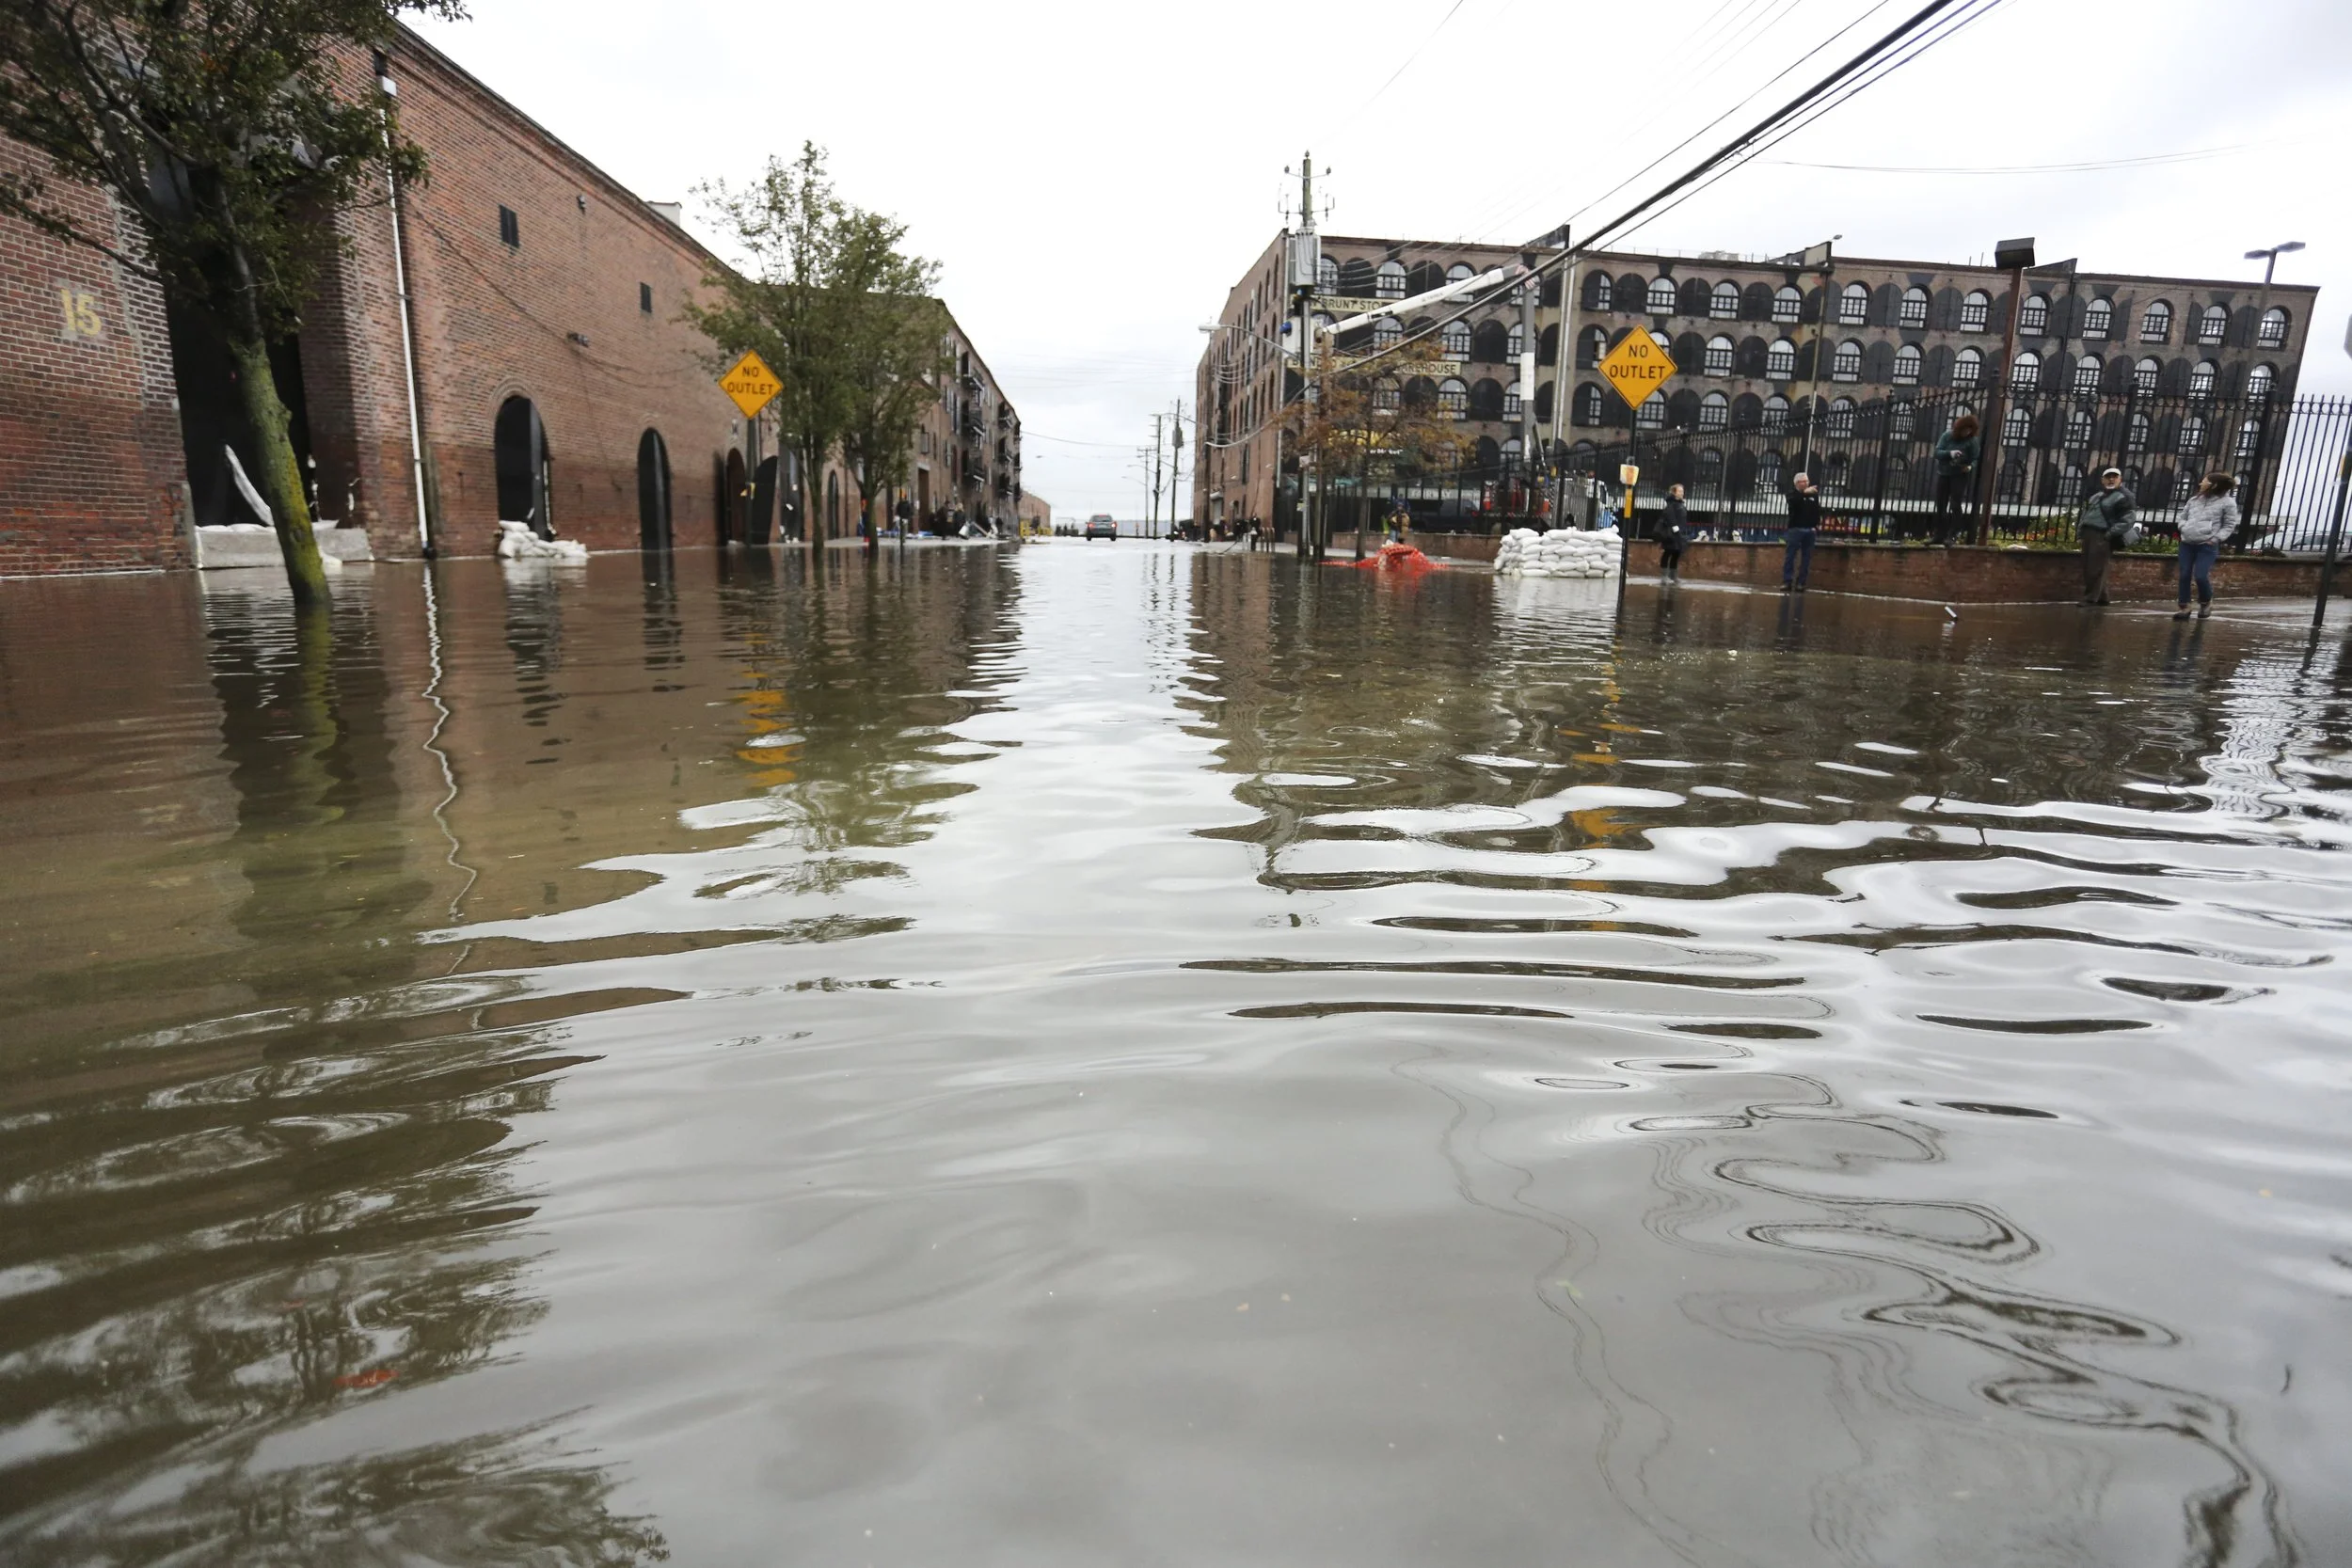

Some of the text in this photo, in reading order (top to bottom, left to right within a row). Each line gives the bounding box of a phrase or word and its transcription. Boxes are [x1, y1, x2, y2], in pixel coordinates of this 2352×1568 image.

[1322, 297, 1357, 309] BRUNT
[60, 288, 102, 336] 15
[1629, 344, 1648, 358] NO
[742, 366, 760, 377] NO
[1609, 365, 1666, 379] OUTLET
[726, 382, 773, 395] OUTLET
